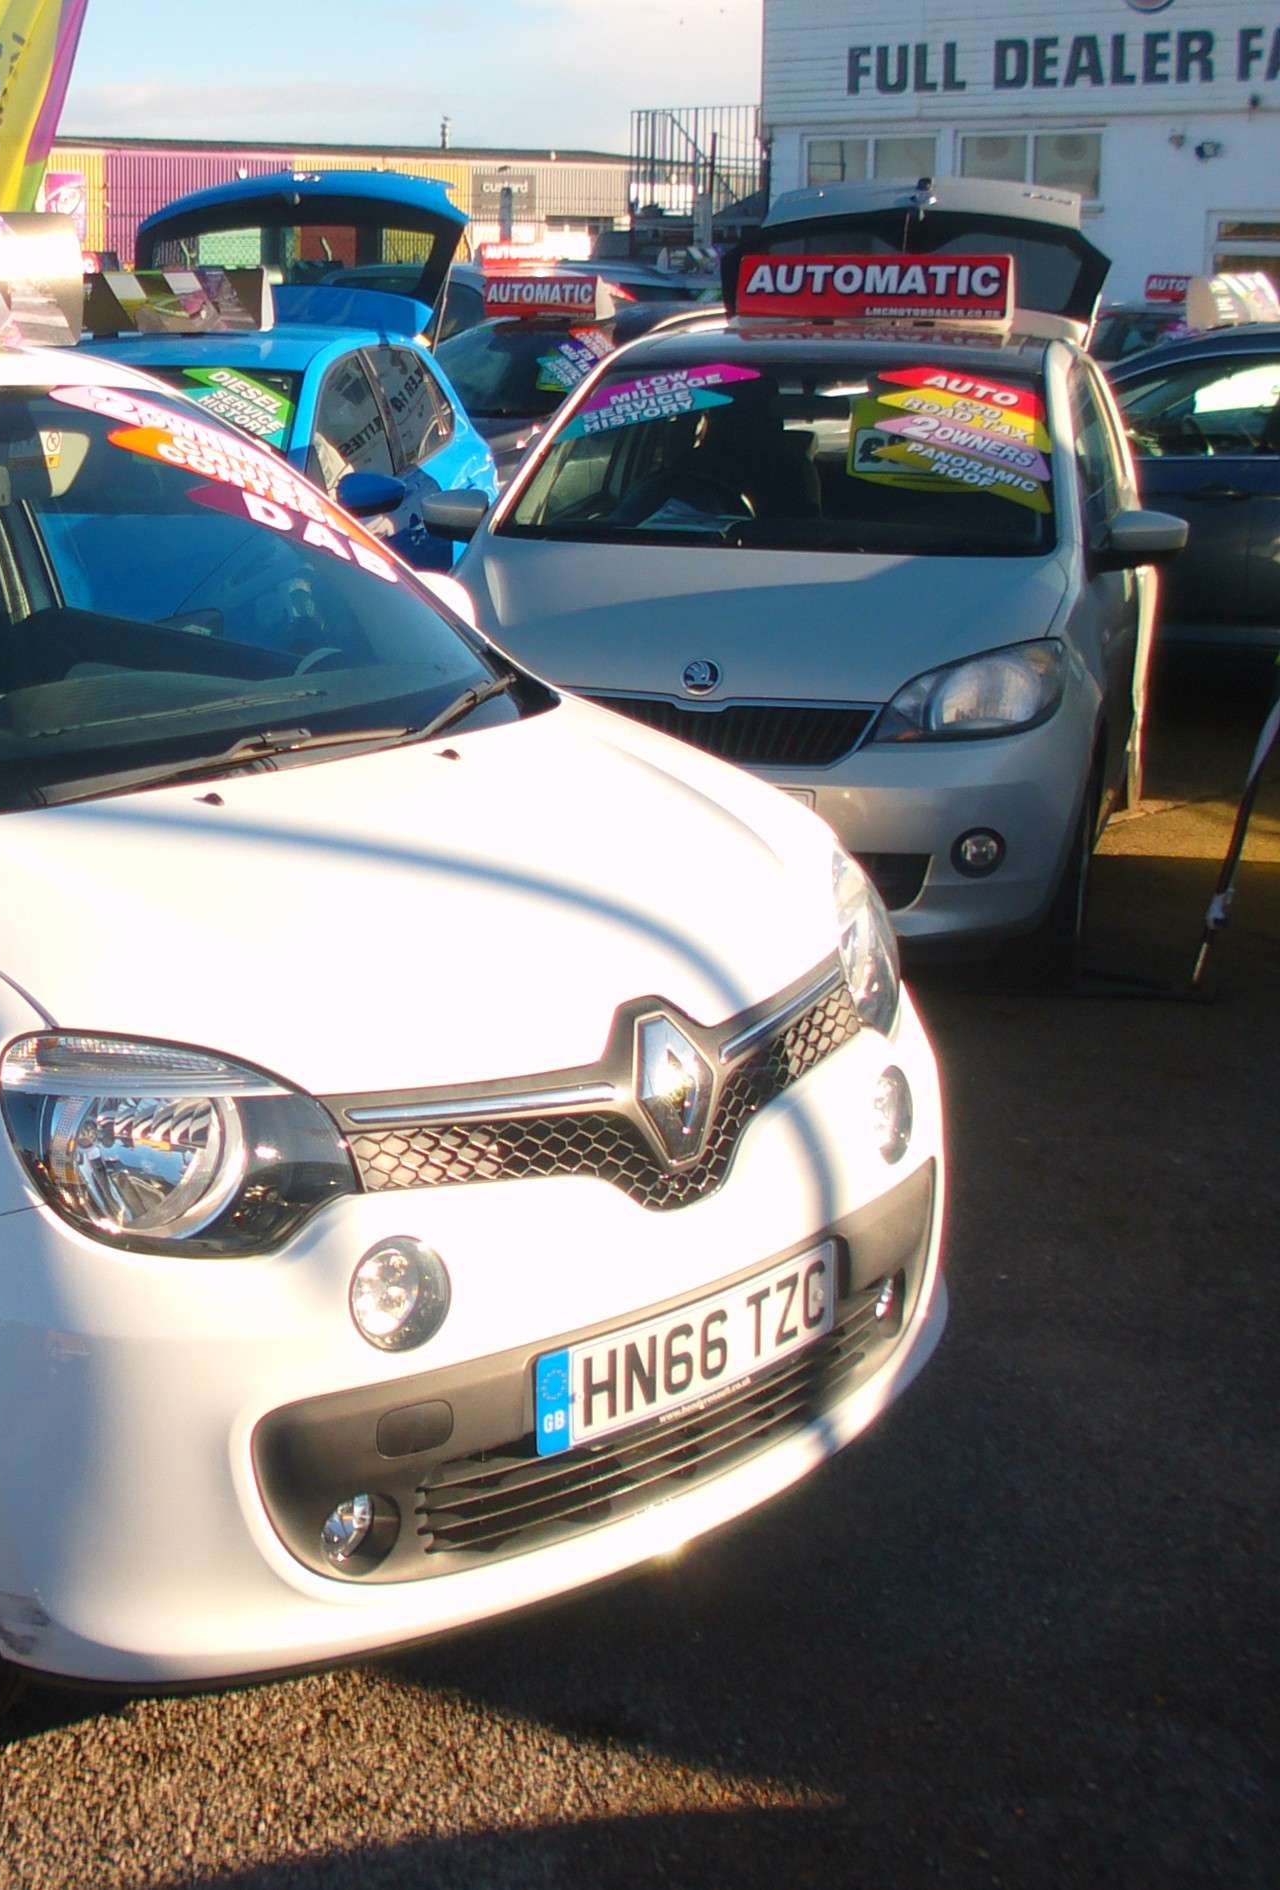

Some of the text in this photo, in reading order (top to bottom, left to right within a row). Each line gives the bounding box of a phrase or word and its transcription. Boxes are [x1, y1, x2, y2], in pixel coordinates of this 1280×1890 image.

[847, 42, 967, 96] FULL
[993, 29, 1215, 89] DEALER
[487, 283, 593, 304] AUTOMATIC
[746, 264, 1000, 296] AUTOMATIC
[208, 371, 284, 414] DIESEL
[609, 374, 723, 405] MILEAGE
[635, 370, 689, 390] LOW
[923, 375, 1019, 406] AUTO
[197, 394, 273, 436] HISTORY
[211, 389, 285, 431] SERVICE
[583, 389, 691, 423] SERVICE
[584, 400, 694, 433] HISTORY
[902, 398, 1032, 441] ROAD TAX
[906, 442, 1038, 492] PANORAMIC
[931, 461, 998, 487] ROOF
[242, 491, 399, 583] DAB
[583, 1260, 826, 1428] HN66 TZC
[543, 1409, 566, 1434] GB
